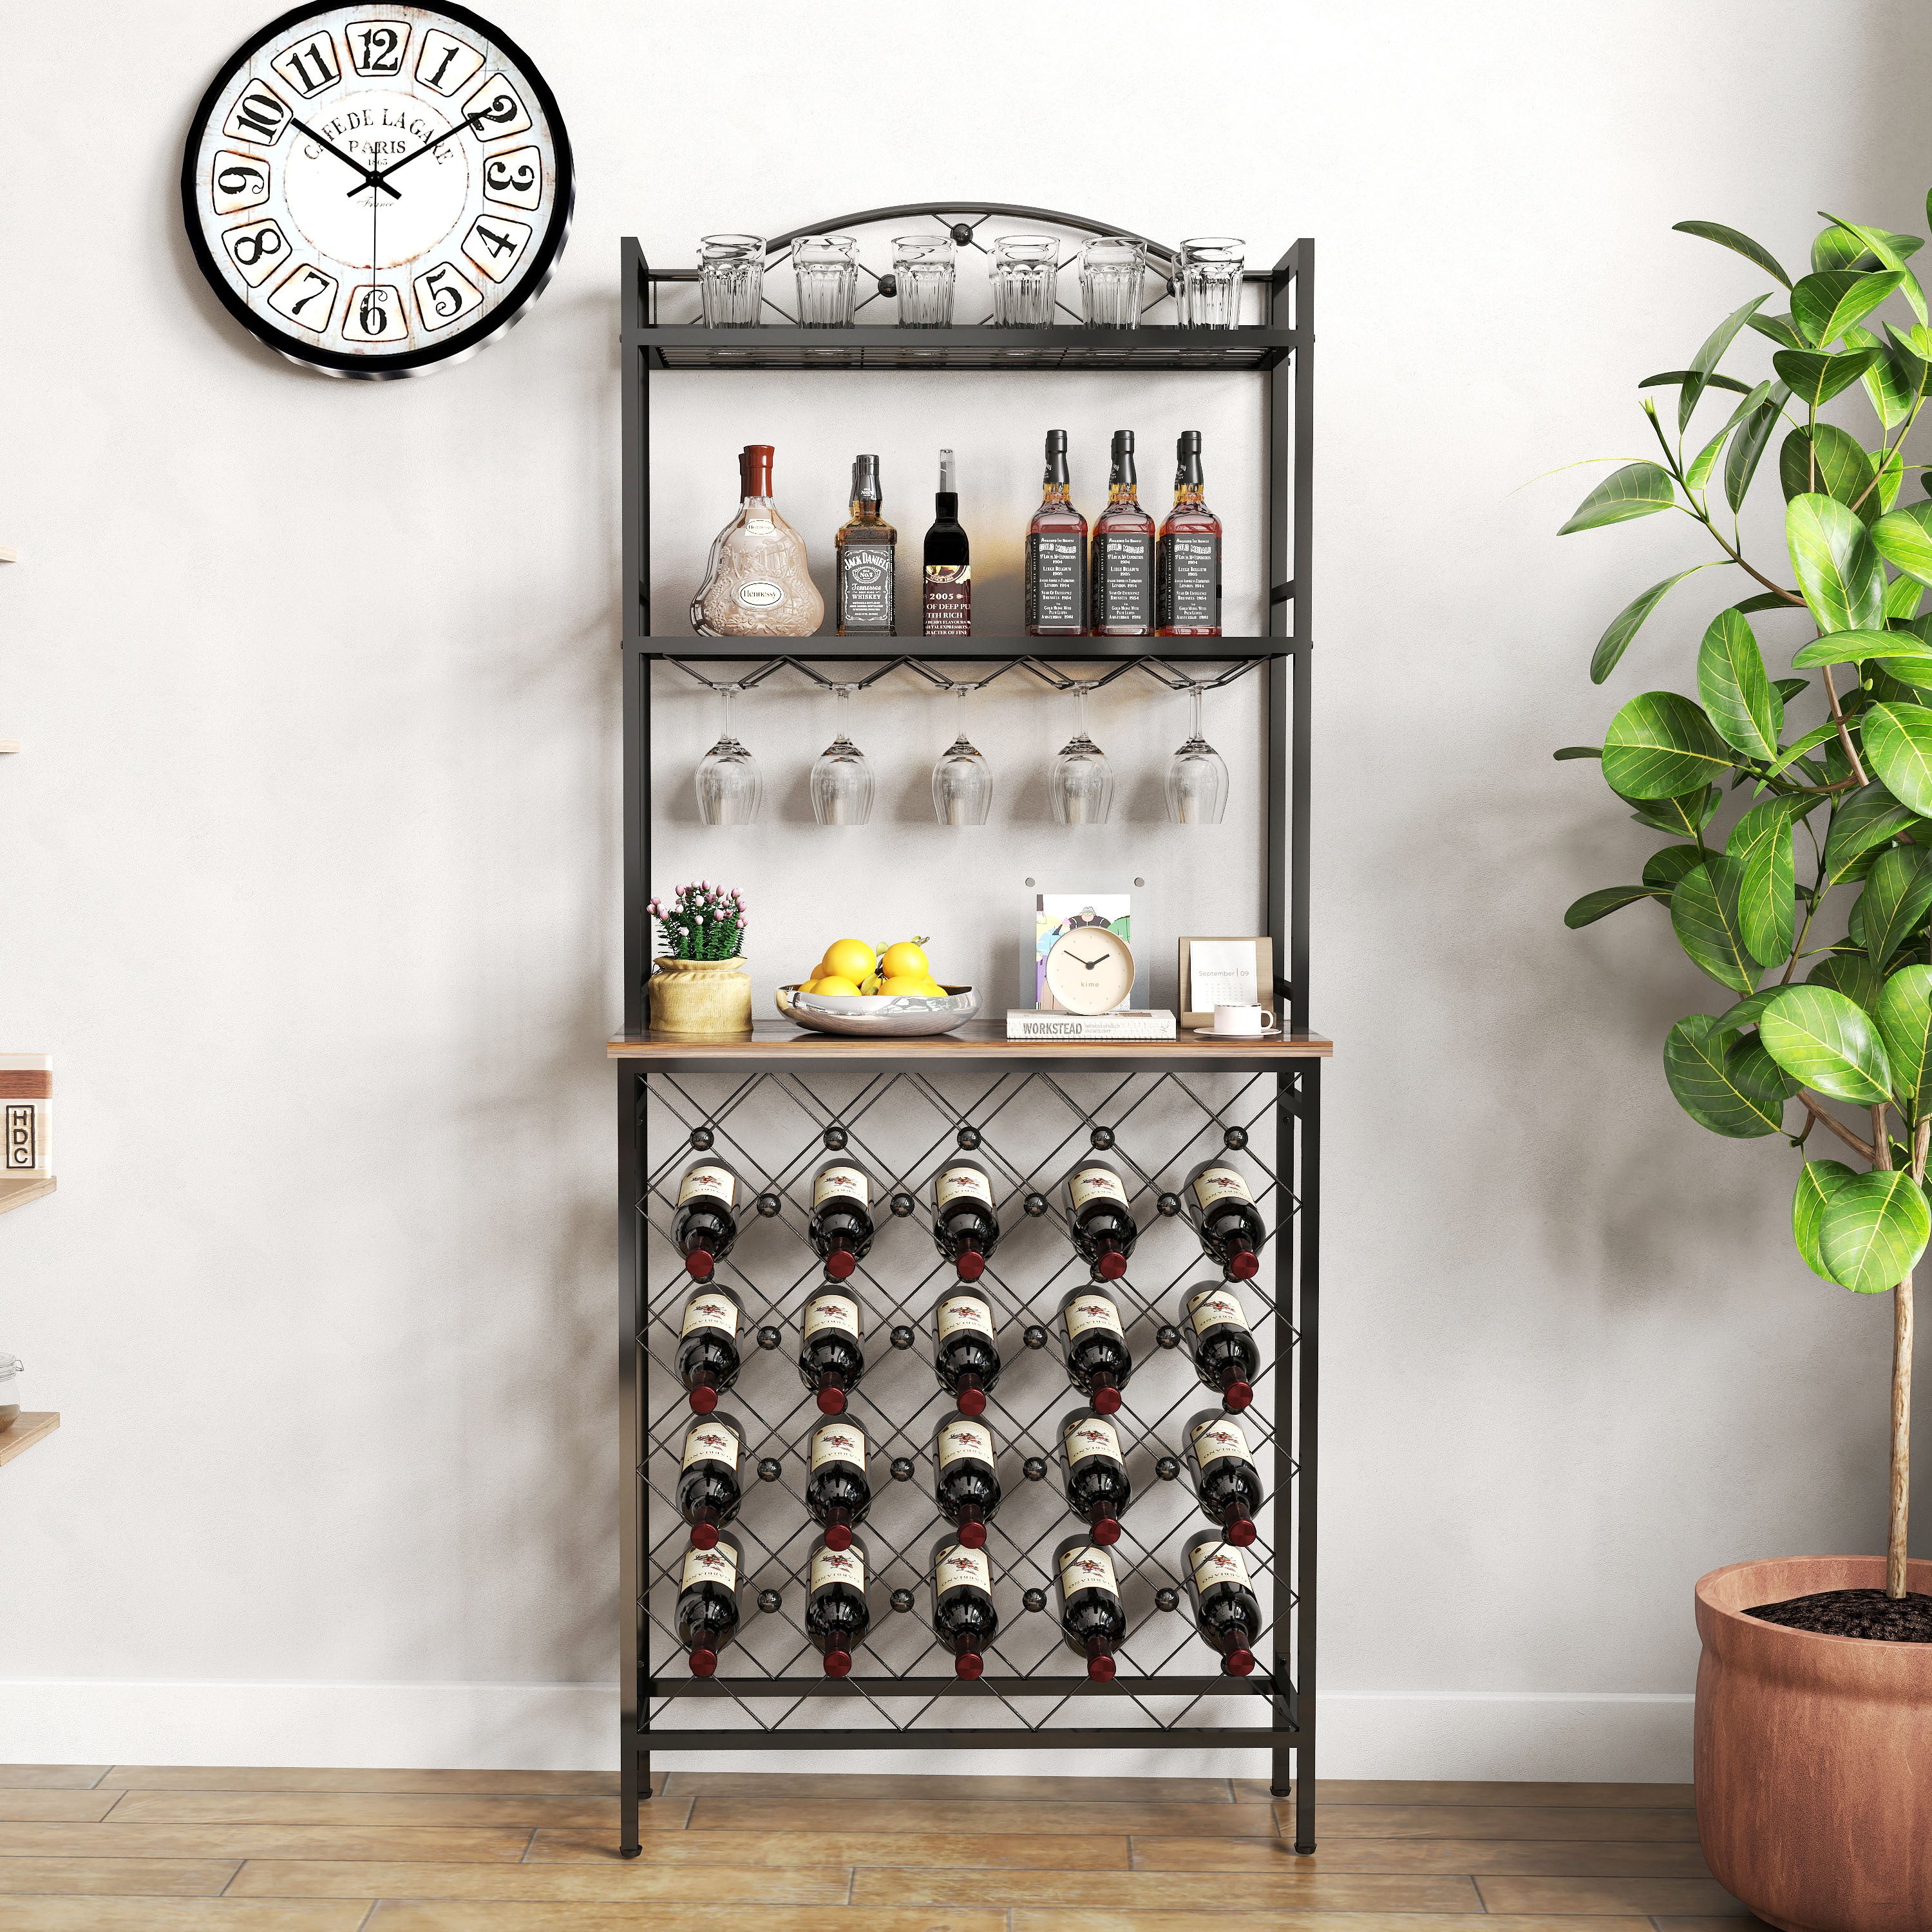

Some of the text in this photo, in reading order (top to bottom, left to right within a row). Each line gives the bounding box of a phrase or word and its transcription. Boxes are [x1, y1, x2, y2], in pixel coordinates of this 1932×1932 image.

[355, 28, 398, 70] 12
[286, 43, 340, 95] 11
[424, 46, 460, 90] 1
[236, 94, 285, 145] 10
[347, 109, 374, 129] DE
[382, 108, 406, 129] LA
[467, 94, 518, 131] 2
[348, 140, 406, 154] PARIS
[217, 166, 264, 195] 9
[487, 161, 535, 192] 3
[234, 227, 281, 266] 8
[476, 224, 518, 258] 4
[292, 272, 330, 315] 7
[426, 269, 463, 317] 5
[359, 289, 388, 335] 6
[844, 554, 862, 571] JACK
[744, 590, 776, 599] Hennessy
[1023, 1023, 1083, 1034] WORKSTEAD
